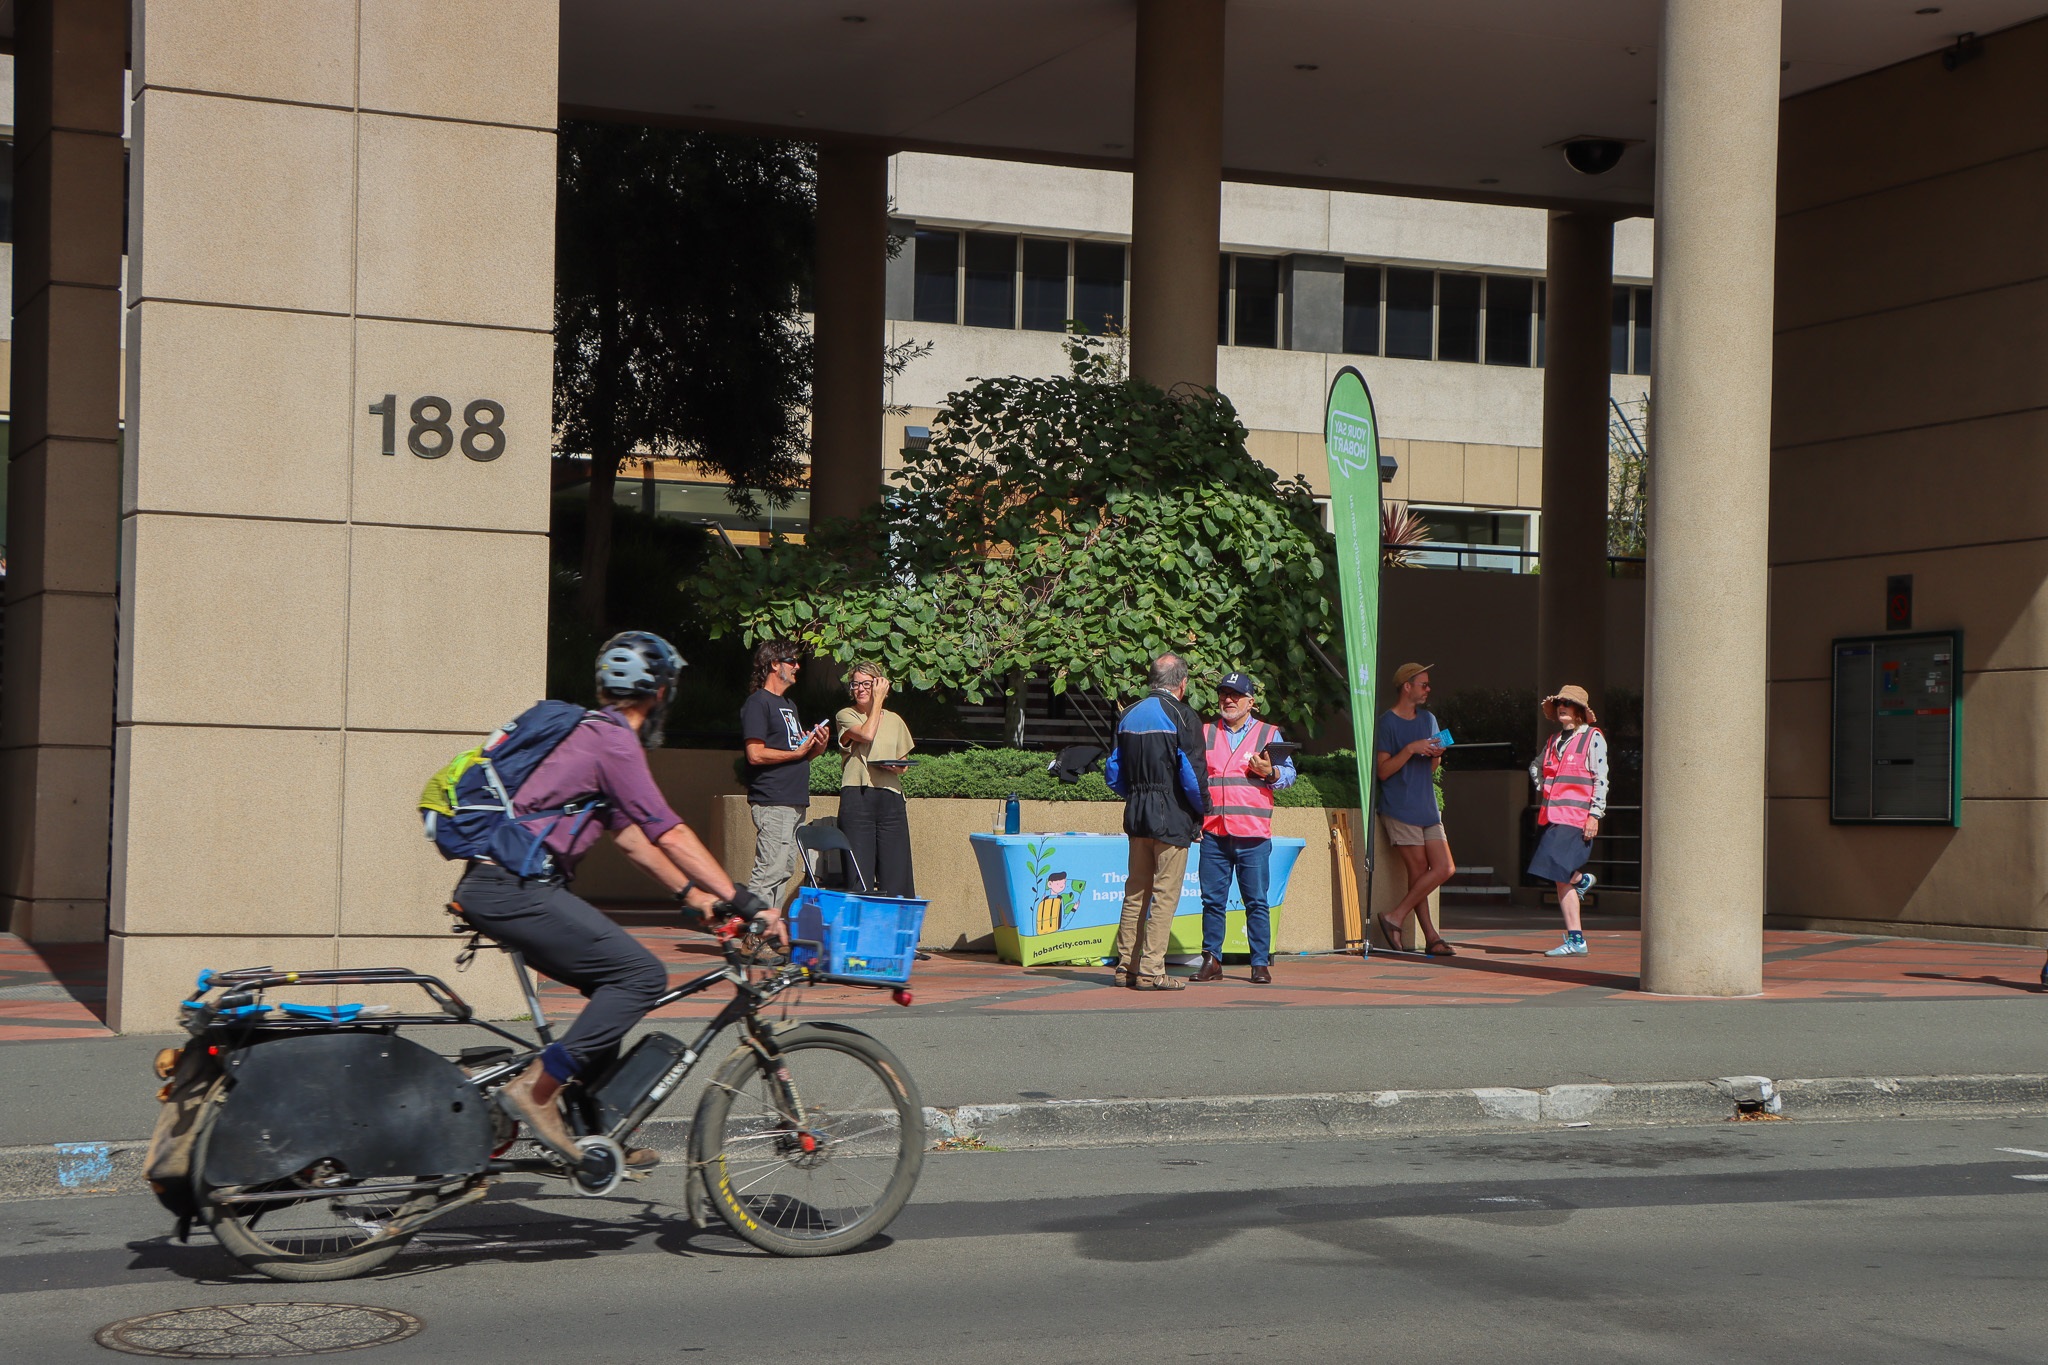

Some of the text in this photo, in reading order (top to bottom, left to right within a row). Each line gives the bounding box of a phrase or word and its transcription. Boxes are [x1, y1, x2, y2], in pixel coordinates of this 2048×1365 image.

[369, 394, 506, 462] 188
[1230, 673, 1238, 681] H
[1102, 871, 1128, 884] The
[1092, 889, 1126, 902] happ
[1033, 938, 1103, 958] hobartcity.com.au
[718, 1176, 758, 1231] MAXXIS
